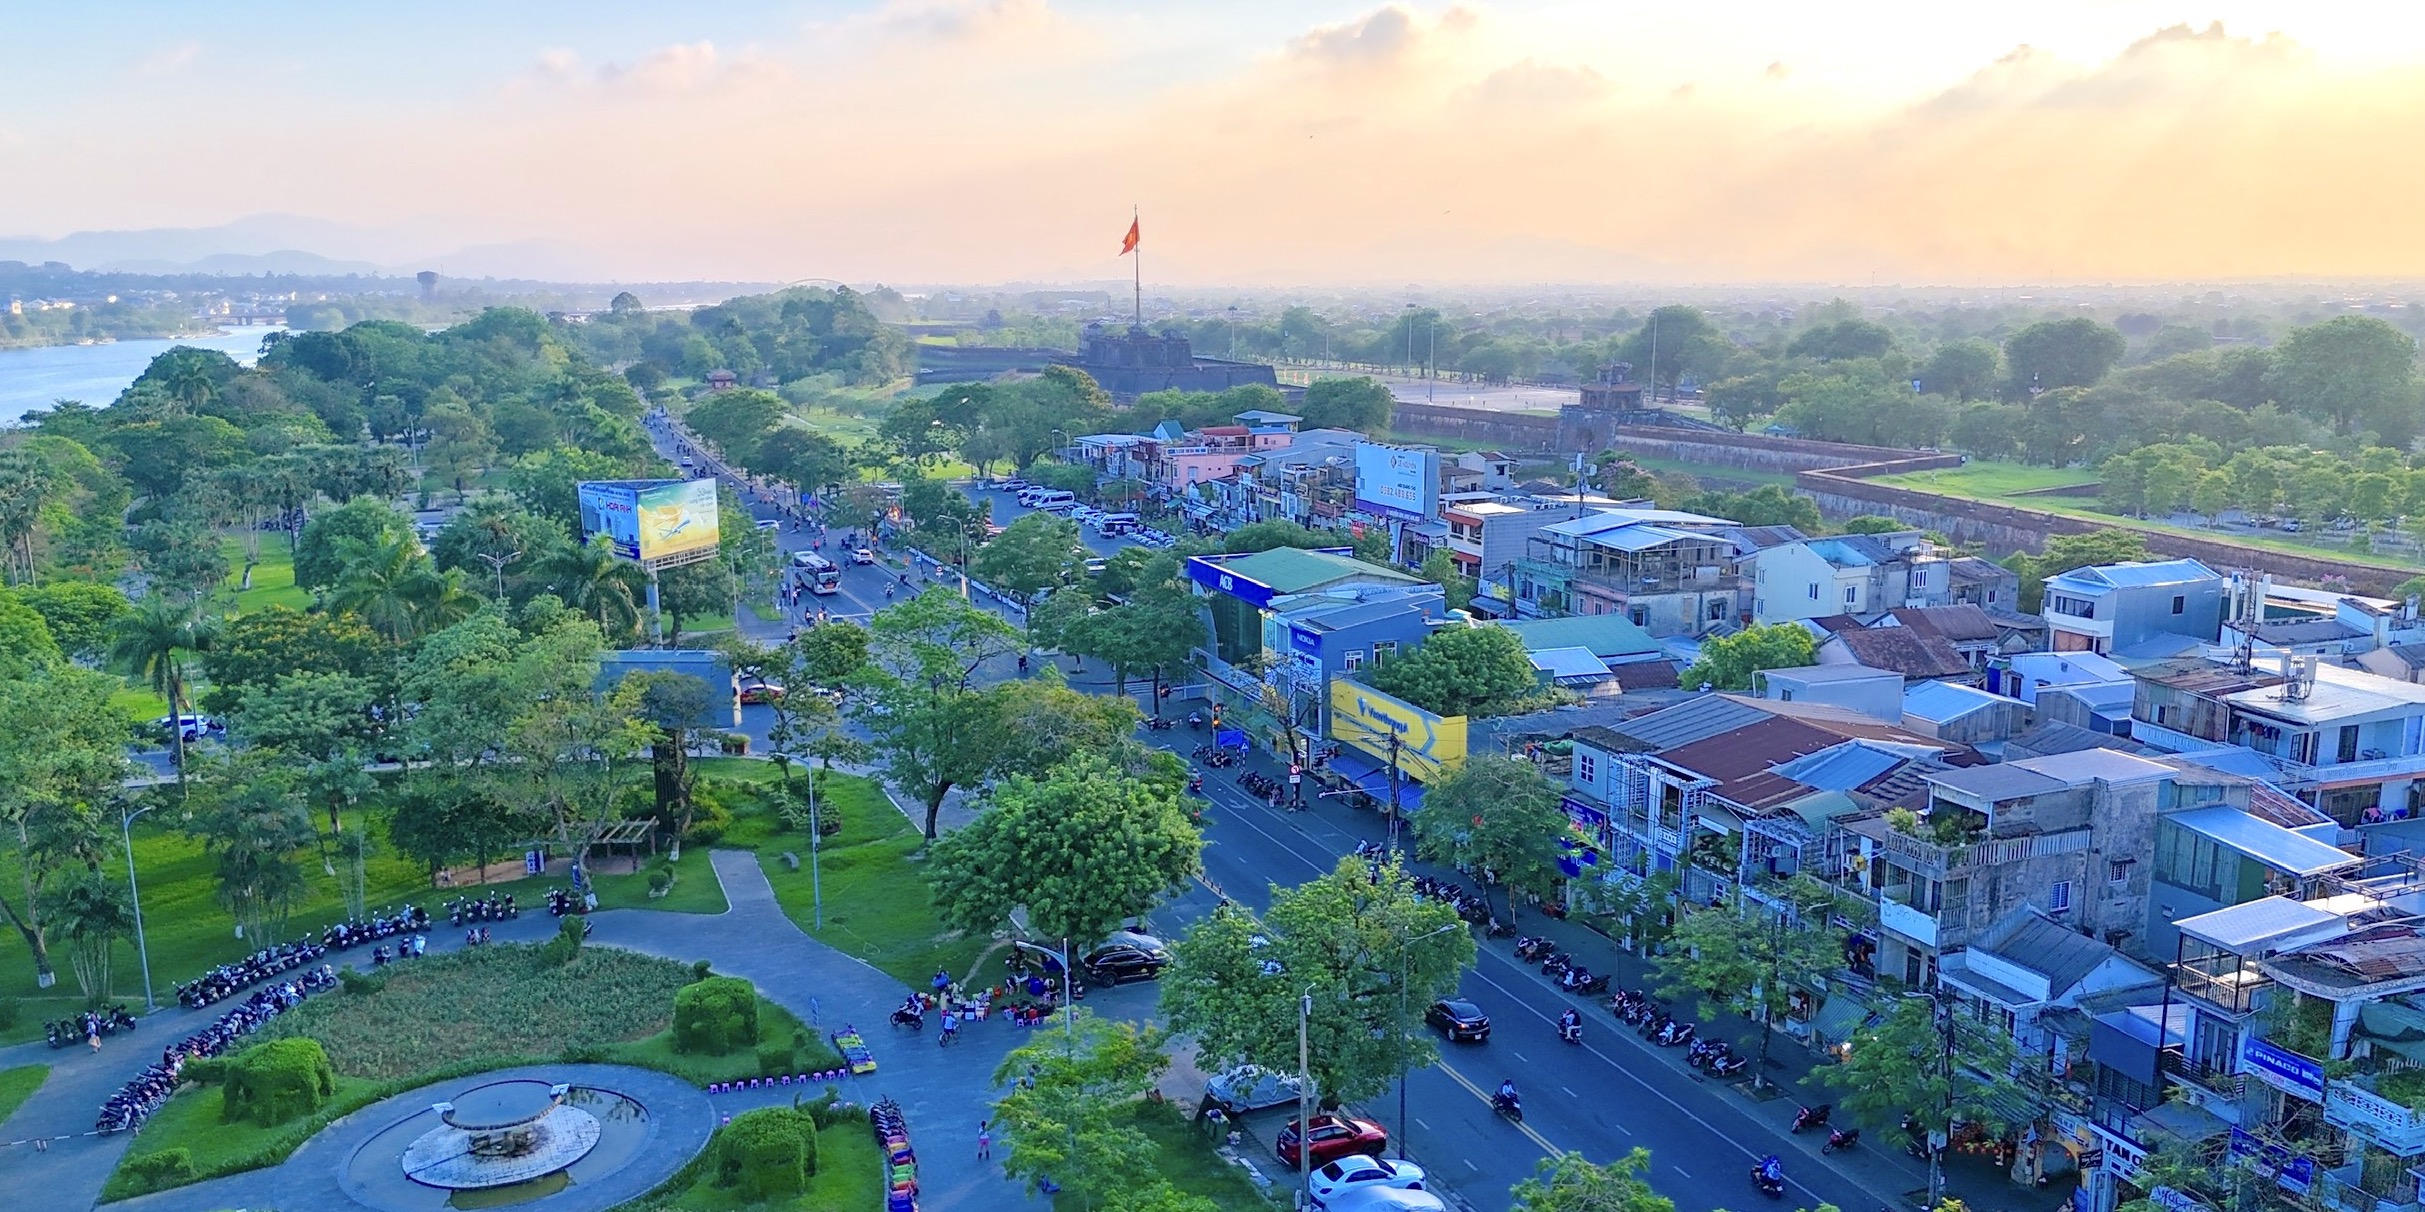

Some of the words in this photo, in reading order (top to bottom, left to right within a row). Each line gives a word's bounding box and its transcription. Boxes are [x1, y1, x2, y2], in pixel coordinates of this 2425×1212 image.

[1219, 574, 1233, 591] ACB
[1296, 632, 1315, 646] NOKIA
[2255, 1050, 2299, 1075] PINACO
